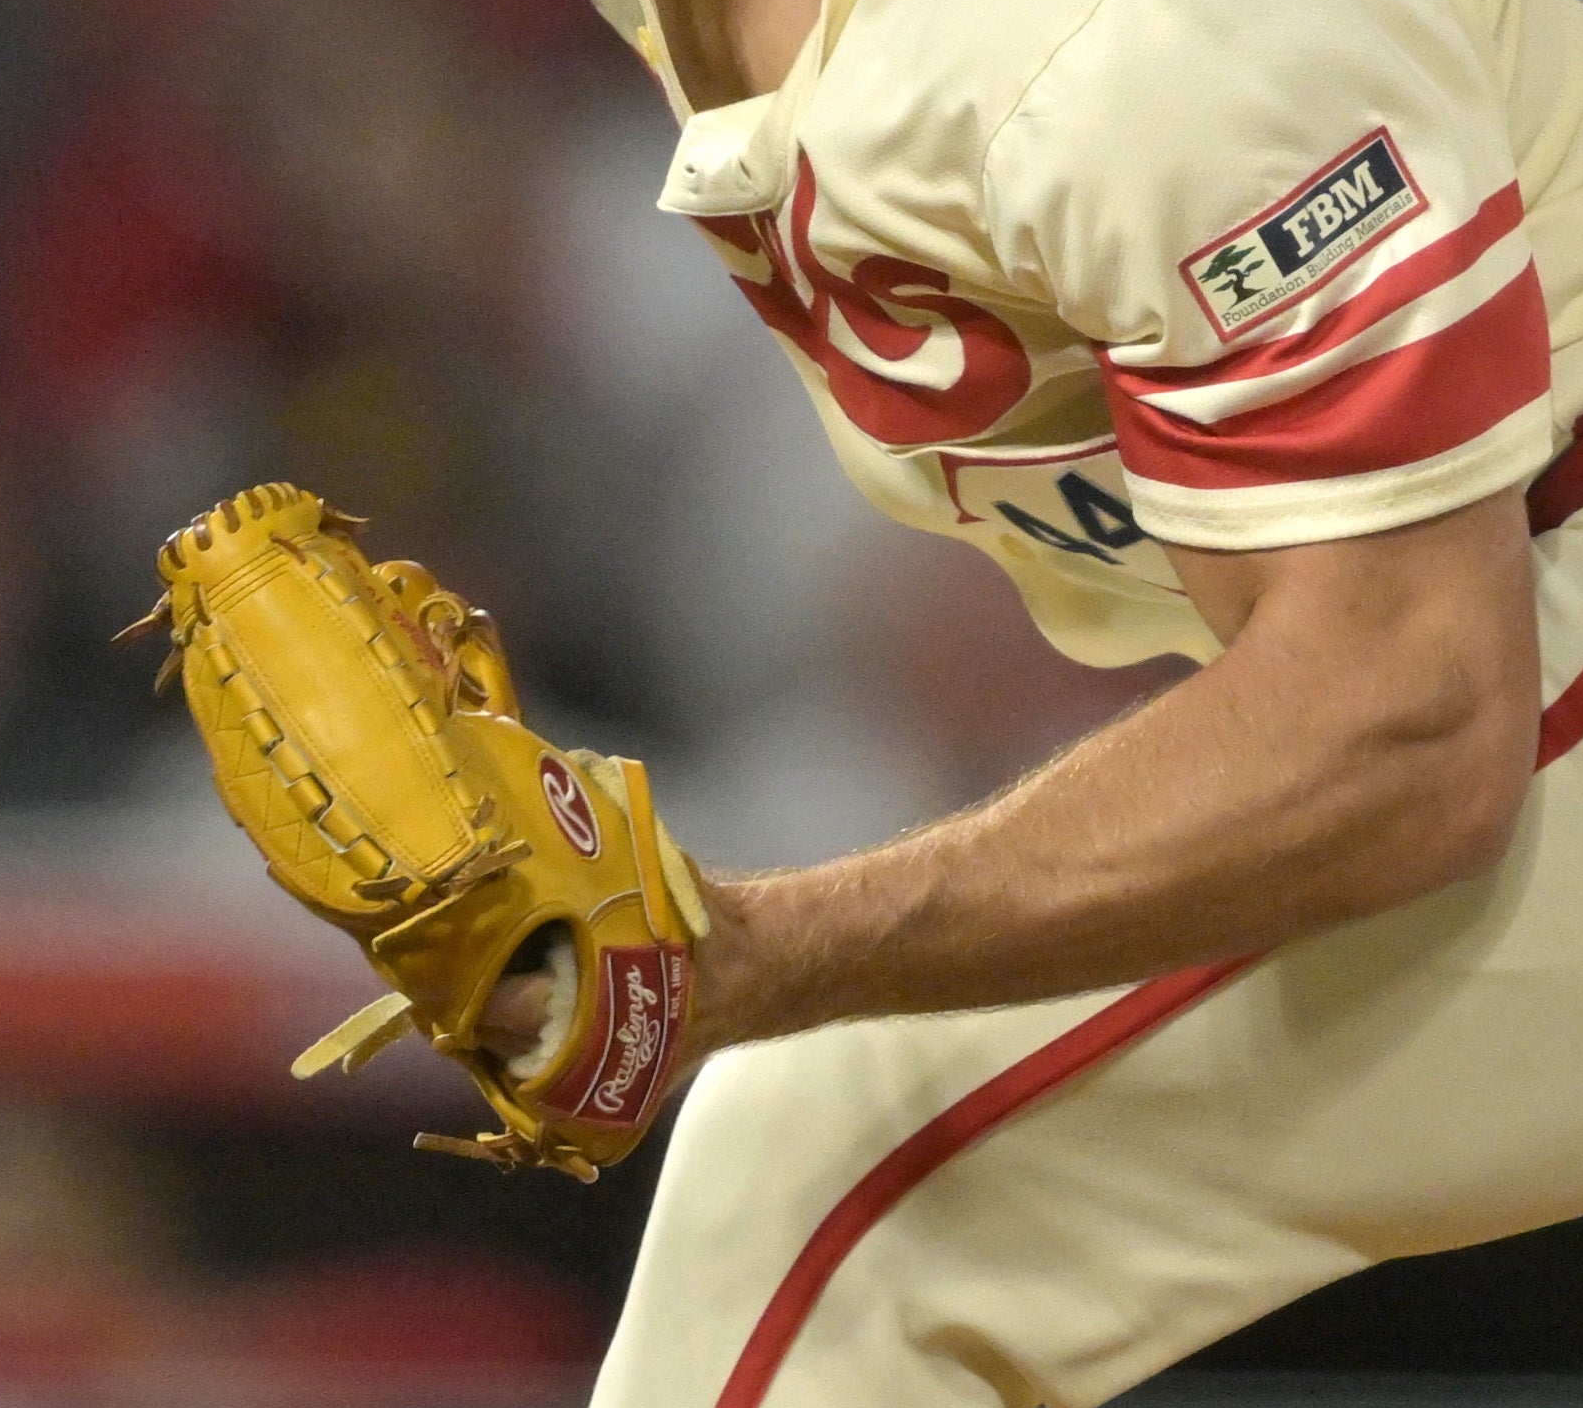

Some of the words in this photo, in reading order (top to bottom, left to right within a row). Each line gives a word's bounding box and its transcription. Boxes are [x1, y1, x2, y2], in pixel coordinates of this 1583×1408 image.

[1221, 275, 1306, 327] Foundation
[1305, 235, 1356, 280] Building
[1354, 191, 1414, 241] Materials
[1282, 160, 1384, 258] FBM
[594, 965, 659, 1113] Rawlings
